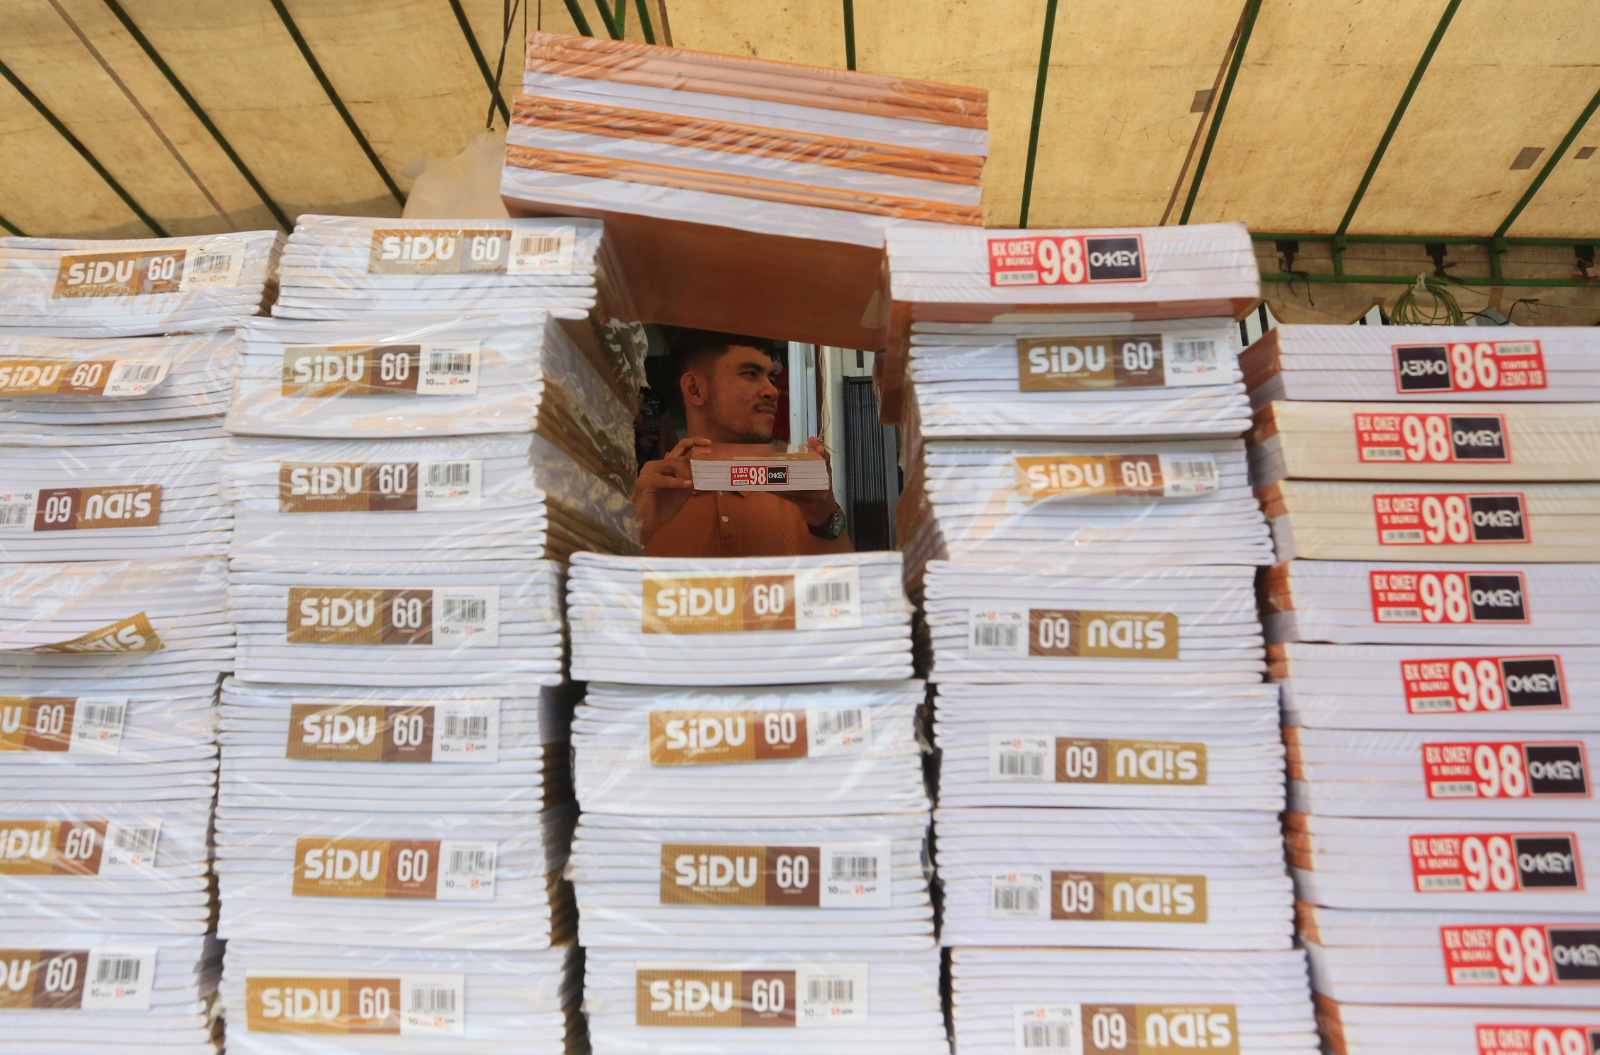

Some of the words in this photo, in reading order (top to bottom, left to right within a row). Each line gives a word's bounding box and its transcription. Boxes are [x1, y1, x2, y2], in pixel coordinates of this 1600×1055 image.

[471, 237, 500, 260] 60
[1008, 242, 1036, 255] OKEY
[1038, 238, 1084, 283] 98
[148, 257, 175, 281] 60
[381, 353, 409, 381] 60
[1123, 342, 1153, 371] 60
[1453, 343, 1498, 389] 98
[71, 364, 103, 387] 60
[1403, 416, 1449, 461] 98
[379, 465, 408, 494] 60
[750, 467, 766, 484] 98
[1121, 461, 1153, 487] 60
[44, 496, 72, 523] 60
[1422, 496, 1469, 543] 98
[392, 598, 422, 628] 60
[754, 584, 784, 614] 60
[1420, 574, 1468, 622] 98
[1039, 618, 1070, 648] 60
[1452, 660, 1502, 711] 98
[36, 705, 65, 734] 60
[393, 715, 423, 746] 60
[764, 713, 796, 744] 60
[1066, 746, 1098, 778] 60
[1475, 745, 1525, 797] 98
[64, 828, 96, 859] 60
[397, 849, 429, 882] 60
[777, 855, 809, 888] 60
[1463, 836, 1515, 890] 98
[1062, 880, 1094, 913] 60
[1496, 927, 1549, 984] 98
[45, 957, 77, 992] 60
[359, 987, 390, 1019] 60
[752, 979, 785, 1012] 60
[1092, 1013, 1126, 1048] 60
